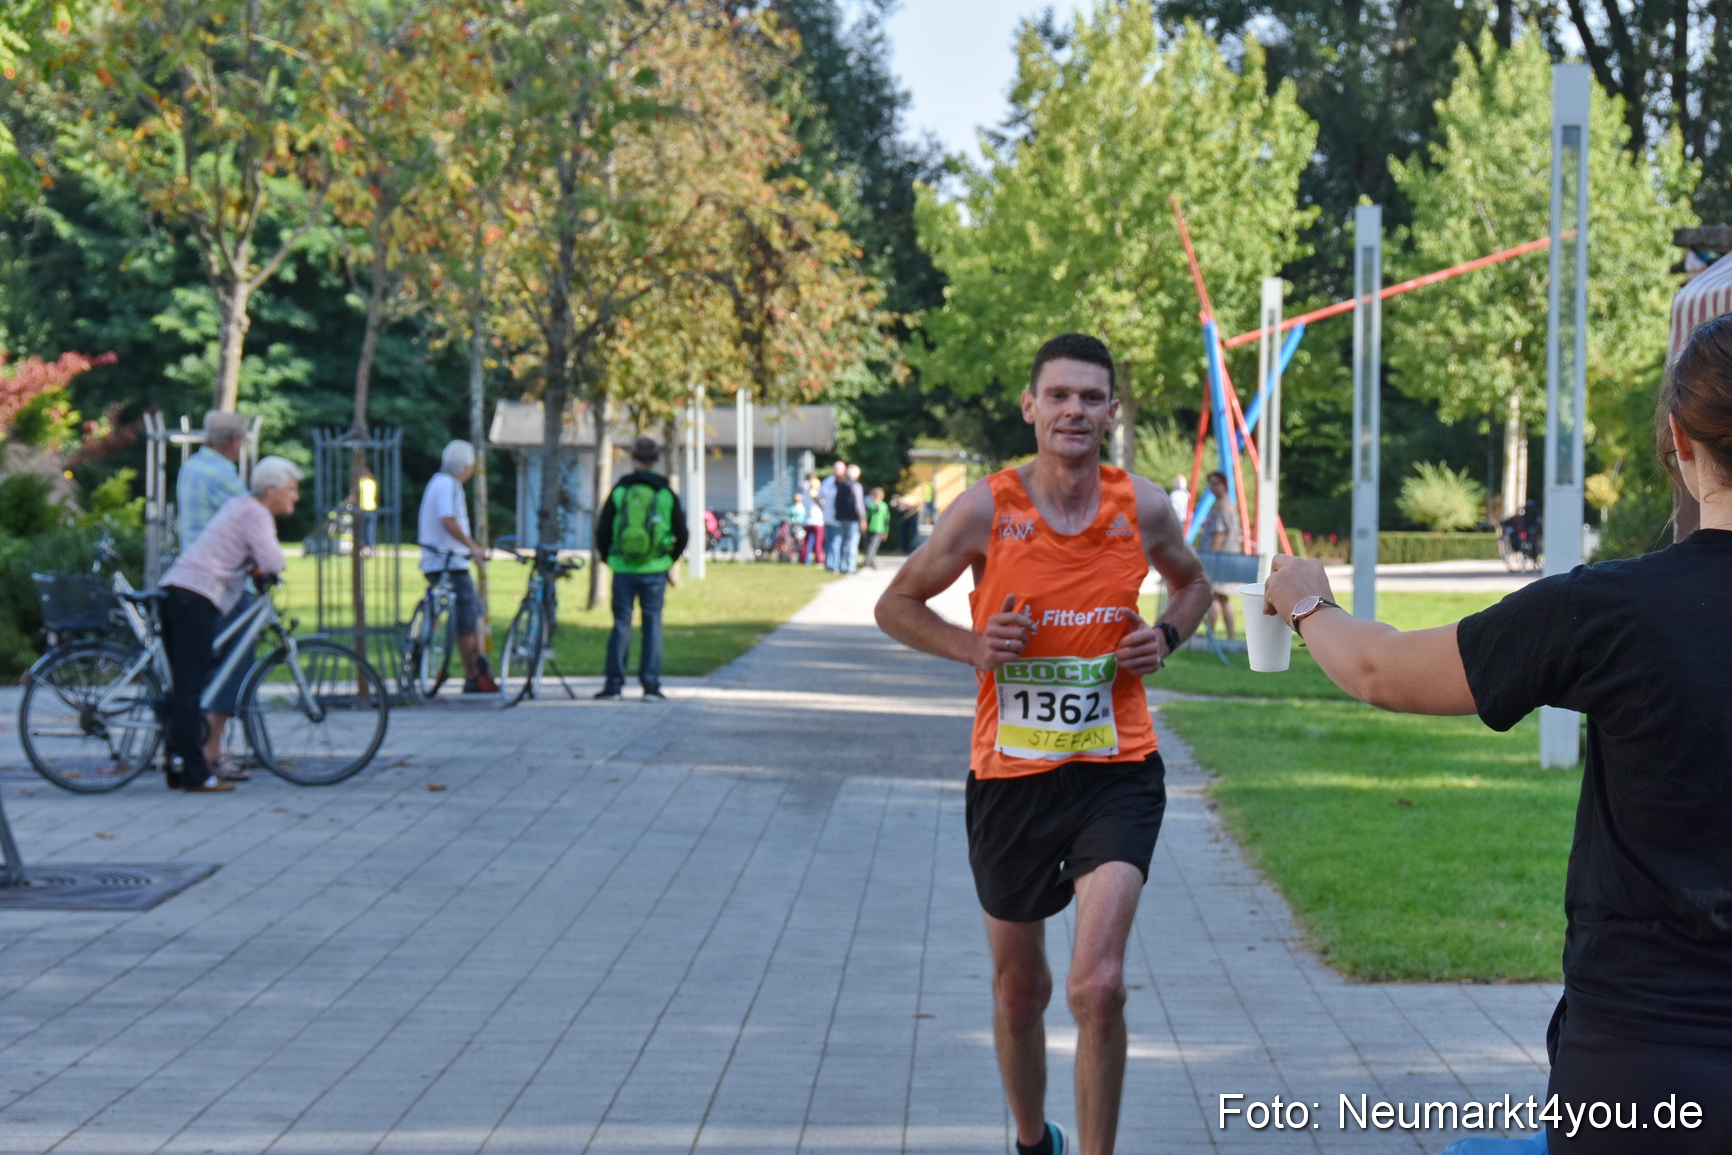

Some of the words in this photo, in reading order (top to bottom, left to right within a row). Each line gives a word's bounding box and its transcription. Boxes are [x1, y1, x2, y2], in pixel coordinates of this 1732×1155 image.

[1006, 663, 1103, 681] BOCK
[1014, 690, 1100, 725] 1362
[1029, 728, 1105, 749] STEFAN
